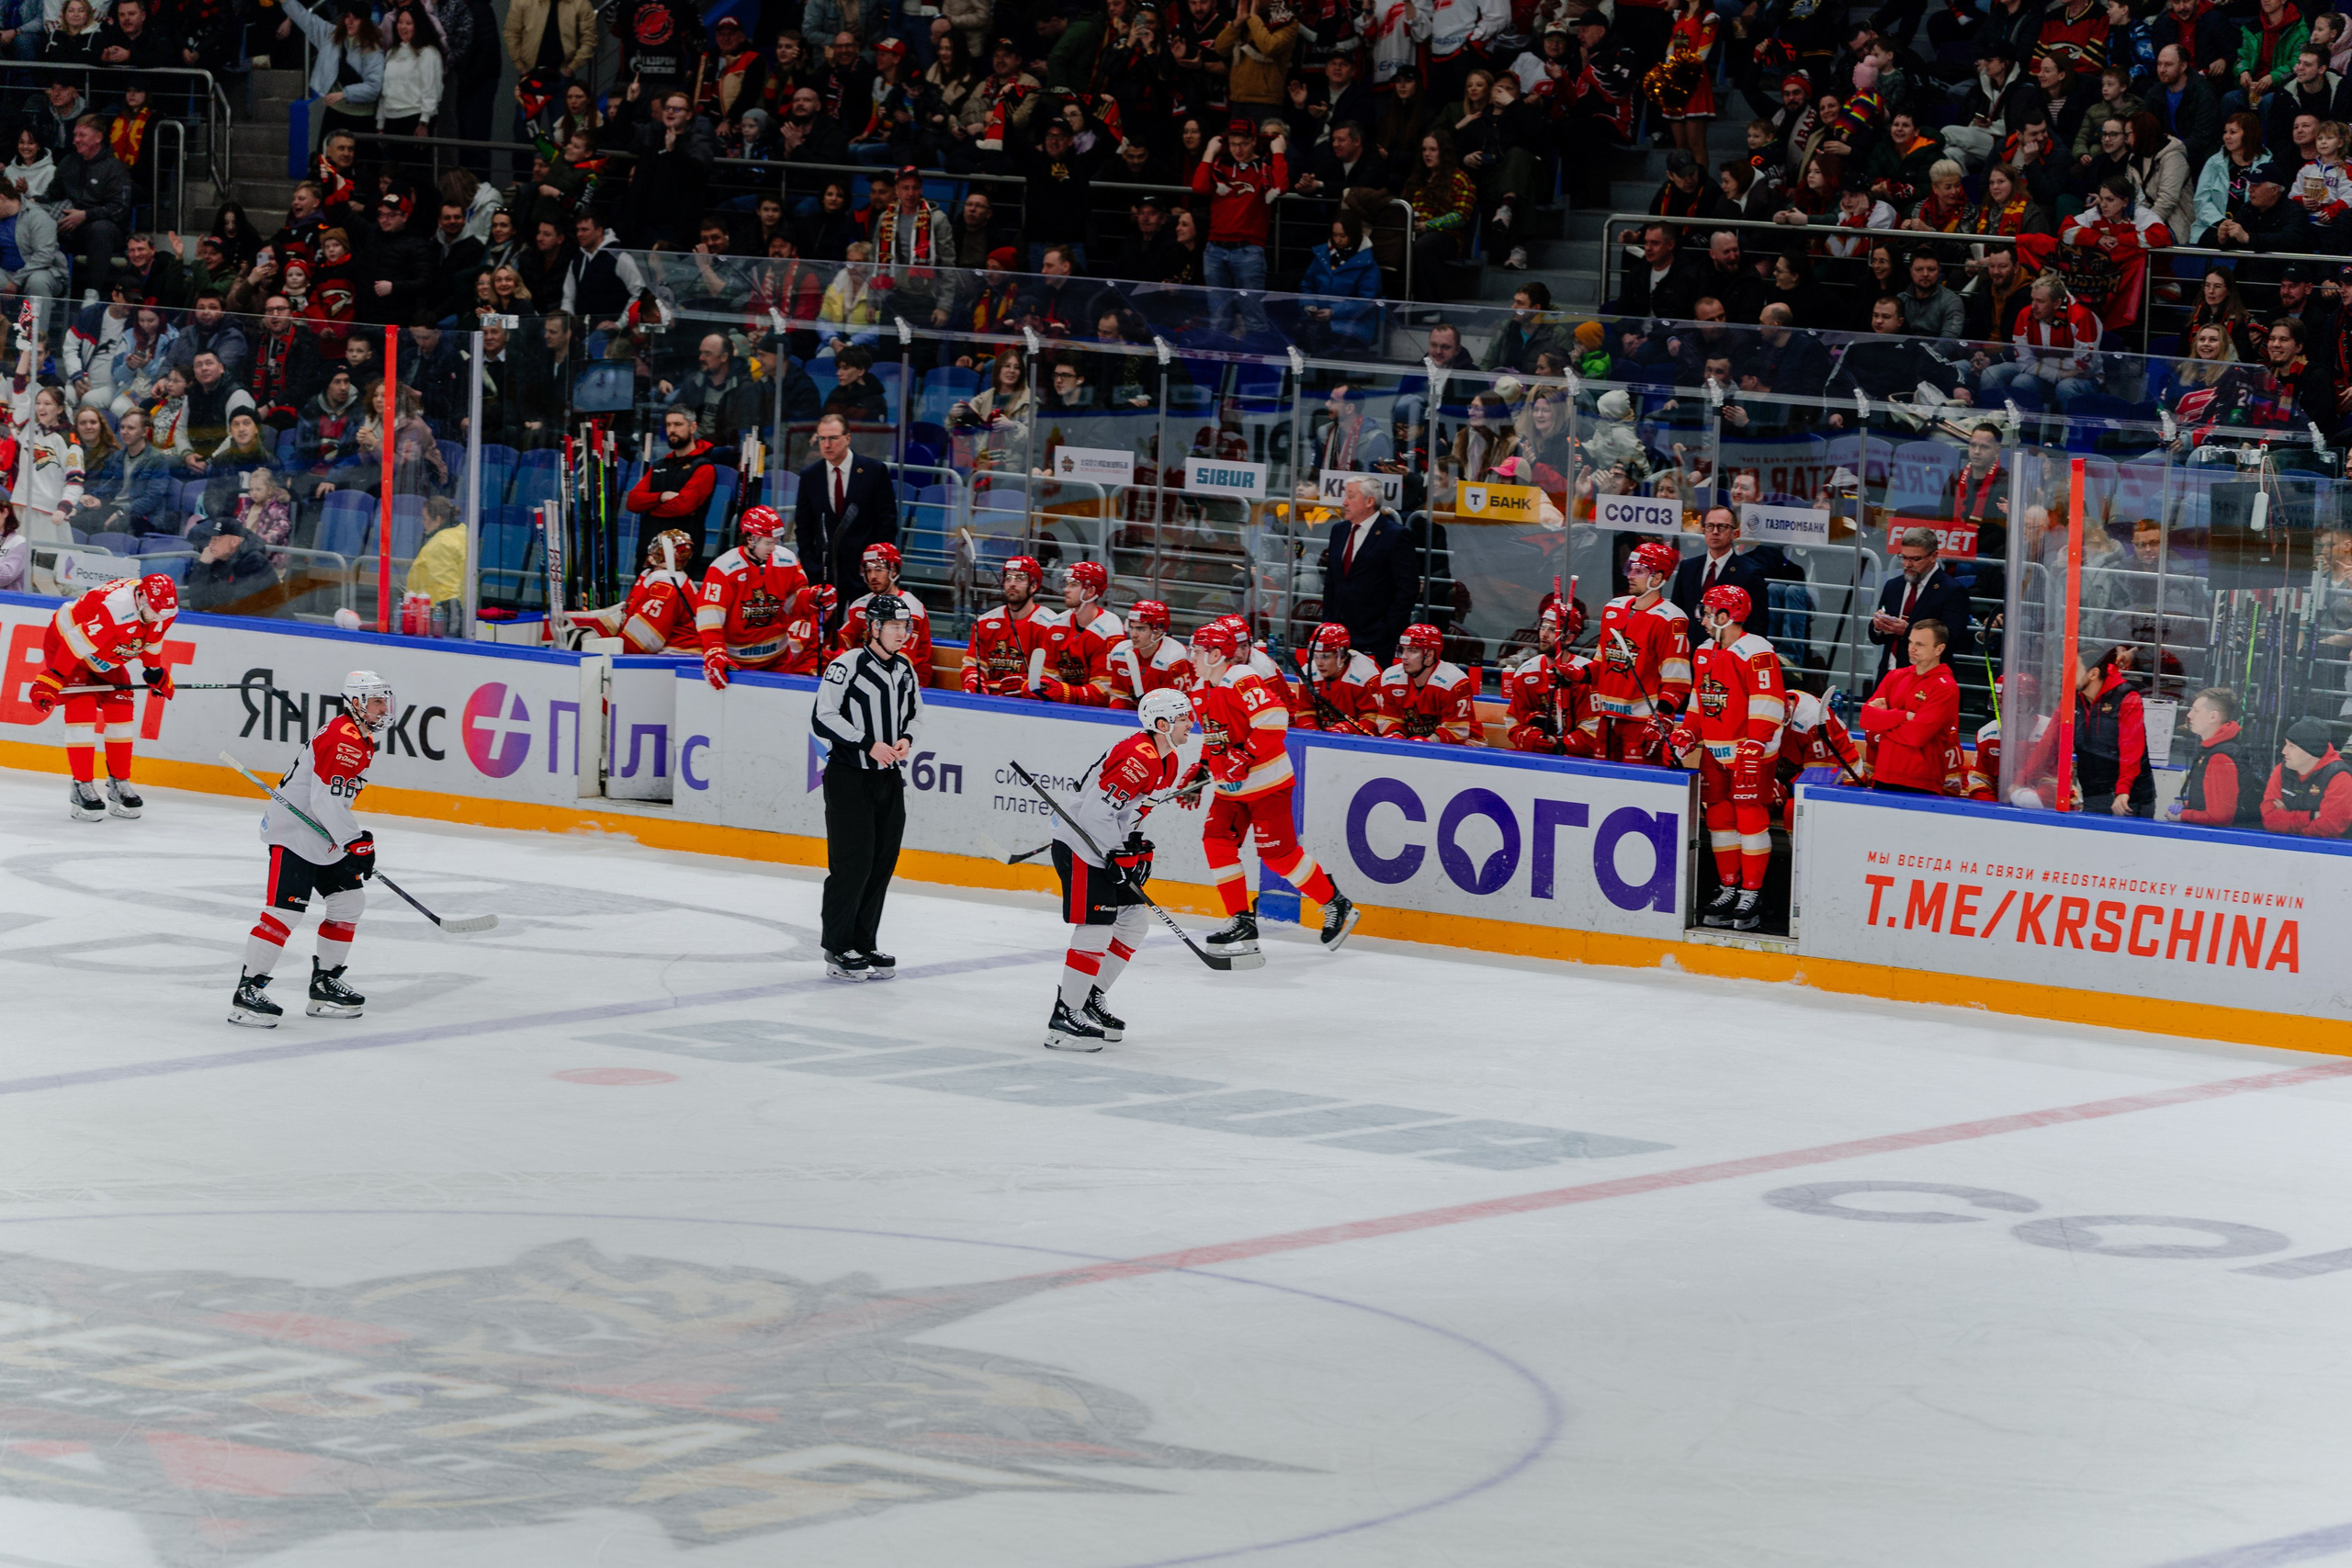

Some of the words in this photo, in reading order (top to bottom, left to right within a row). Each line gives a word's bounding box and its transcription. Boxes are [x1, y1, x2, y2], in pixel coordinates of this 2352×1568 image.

[1196, 467, 1256, 488] SIBUR
[1489, 496, 1532, 510] БАНК
[1765, 517, 1826, 534] ГАЗПРОМБАНК
[1889, 525, 1977, 552] FOBET
[704, 581, 722, 603] 13
[641, 599, 664, 617] 45
[787, 620, 811, 638] 40
[740, 643, 777, 656] SIBUR
[1605, 648, 1639, 664] REDSTR
[826, 663, 848, 683] 96
[1758, 670, 1770, 690] 9
[1242, 687, 1272, 711] 32
[548, 699, 710, 791] Плс
[899, 751, 963, 795] бп
[995, 768, 1075, 792] система
[330, 774, 356, 799] 86
[1102, 784, 1129, 811] 13
[1733, 792, 1758, 800] CCM
[1867, 851, 1890, 865] МЫ
[1898, 854, 1952, 872] ВСЕГДА
[1961, 861, 1978, 874] НА
[1985, 863, 2034, 882] СВЯЗИ
[2041, 870, 2178, 897] #REDSTARHOCKEY
[2184, 886, 2304, 909] #UNITEDWEWIN
[1152, 905, 1186, 941] BAUER
[1865, 874, 2301, 974] T.ME/KRSCHINA
[571, 1018, 1678, 1172] SIBUR
[1760, 1179, 2352, 1280] со
